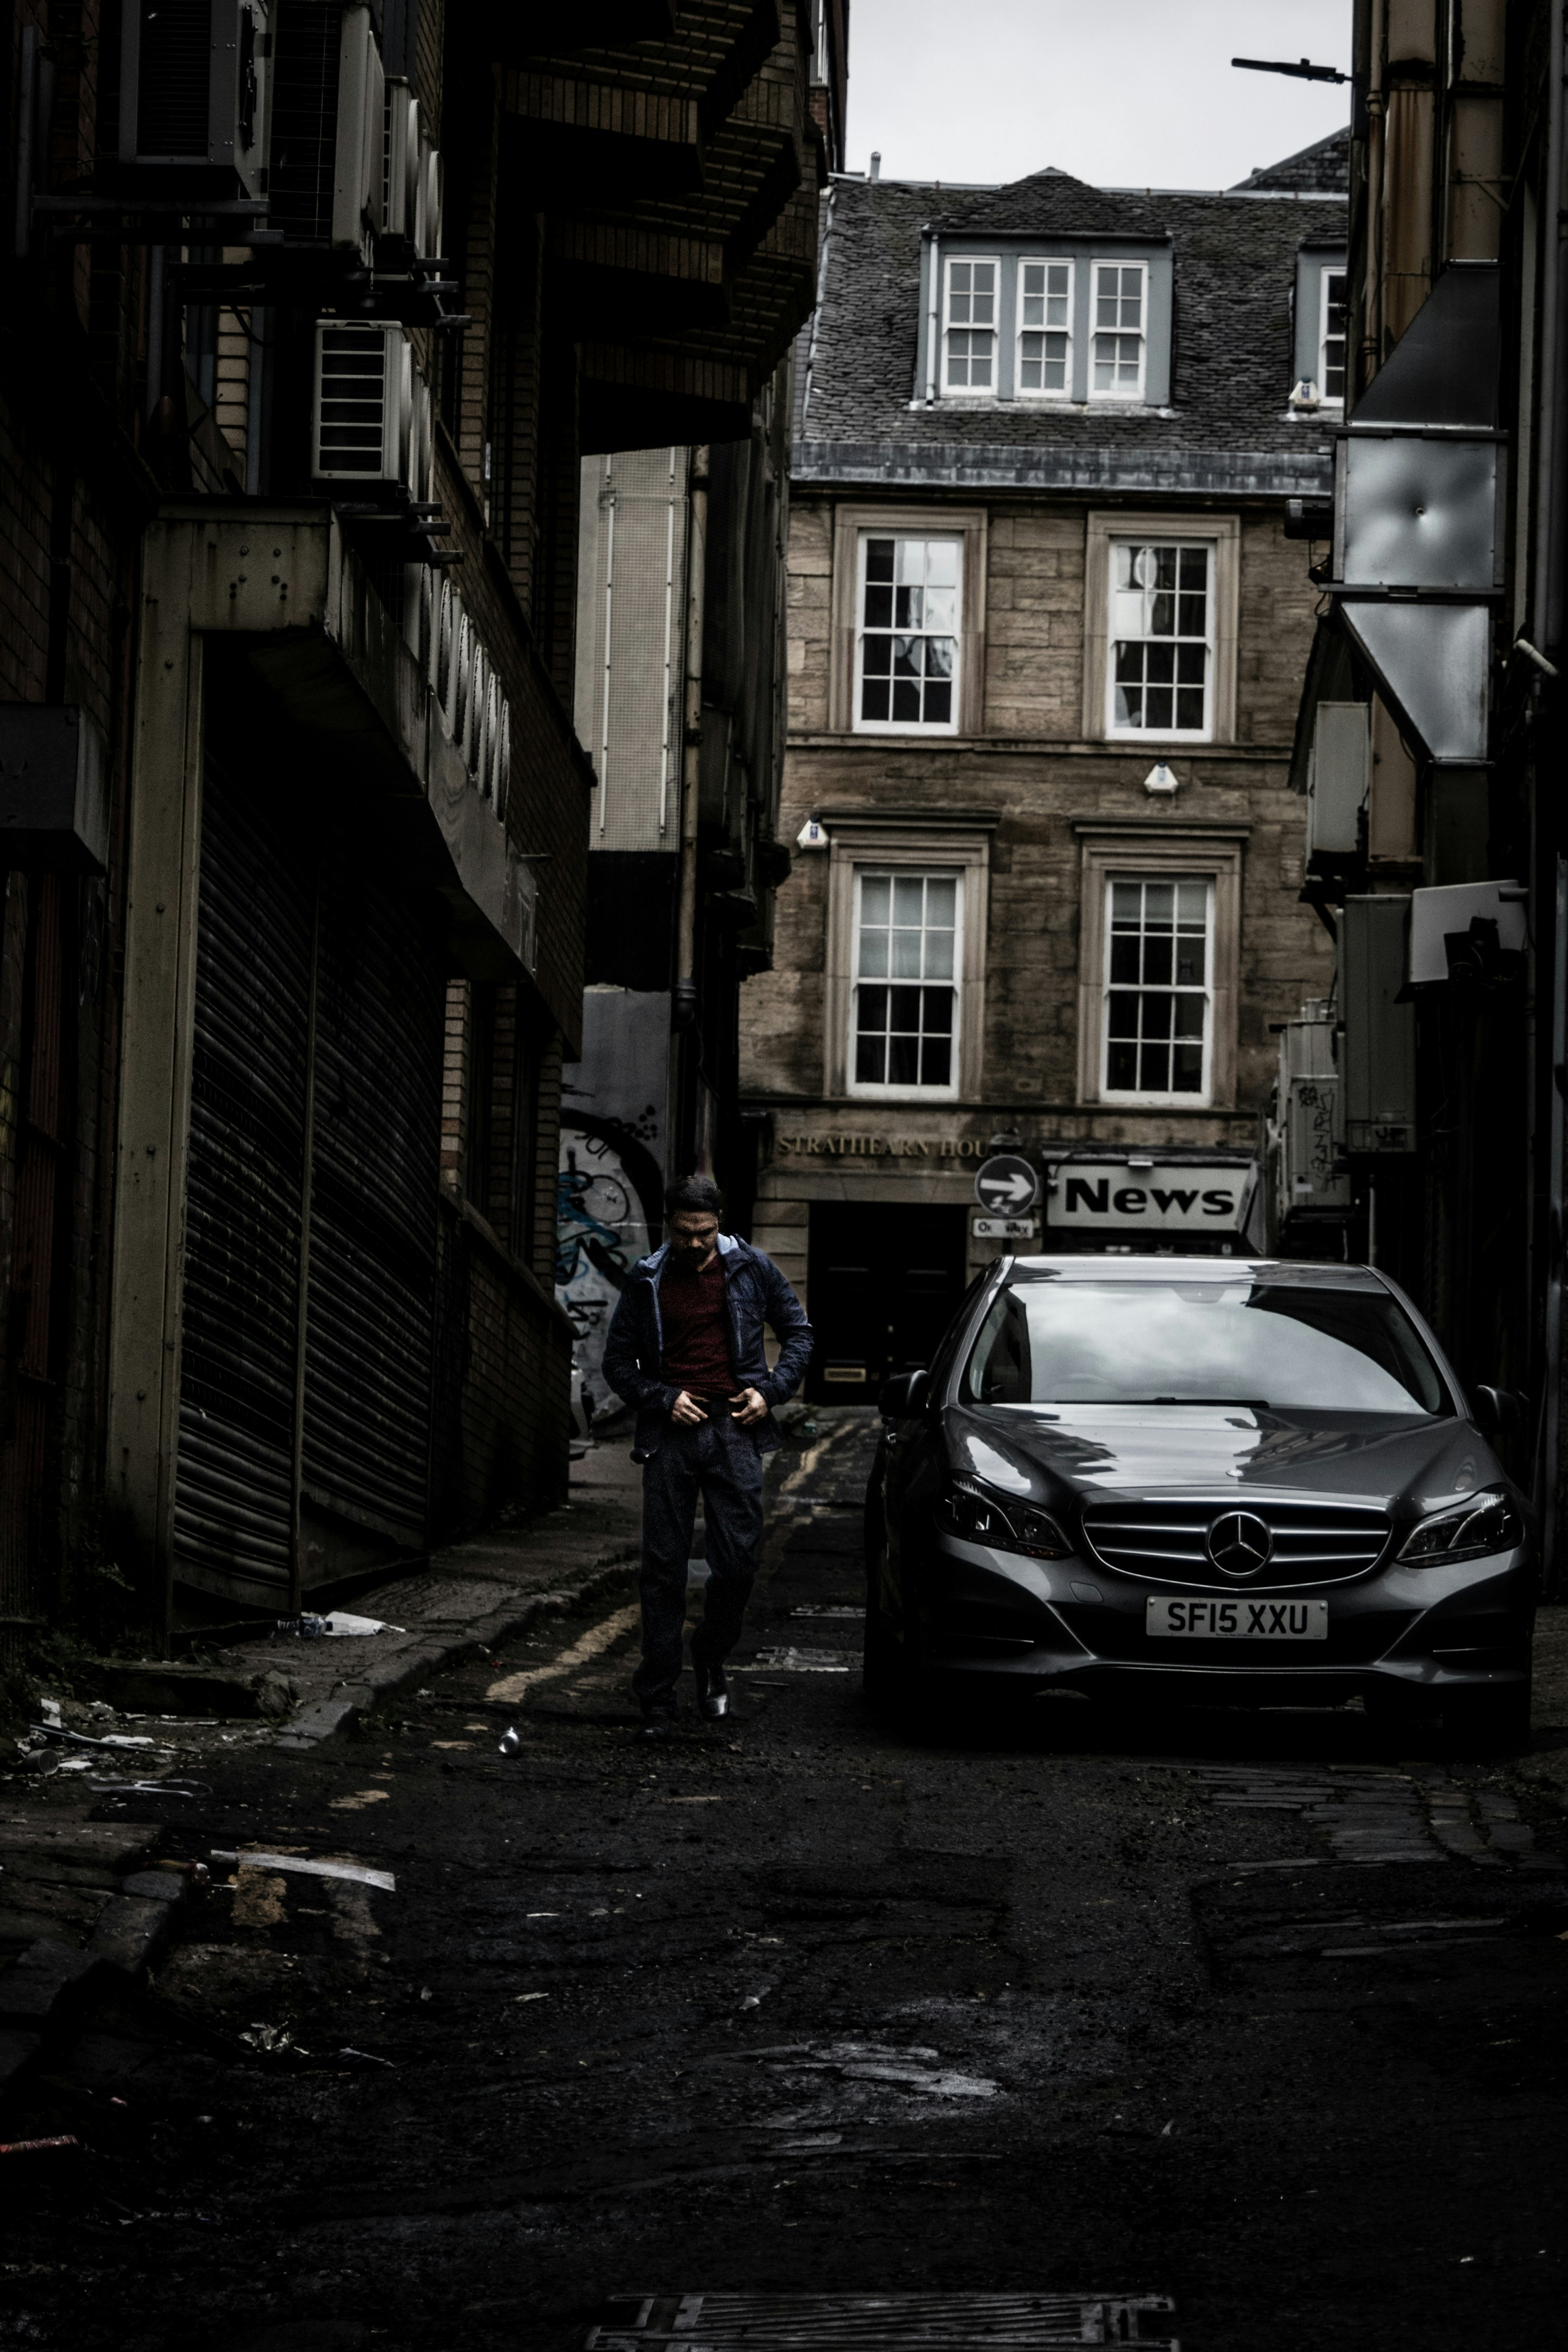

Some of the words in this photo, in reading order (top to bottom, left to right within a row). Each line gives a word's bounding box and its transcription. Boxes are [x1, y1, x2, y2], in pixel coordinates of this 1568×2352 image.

[778, 1136, 929, 1157] STRATHEARN
[939, 1140, 990, 1158] HOU
[1065, 1178, 1234, 1215] News
[1168, 1602, 1238, 1633] SF15
[1247, 1604, 1308, 1634] XXU
